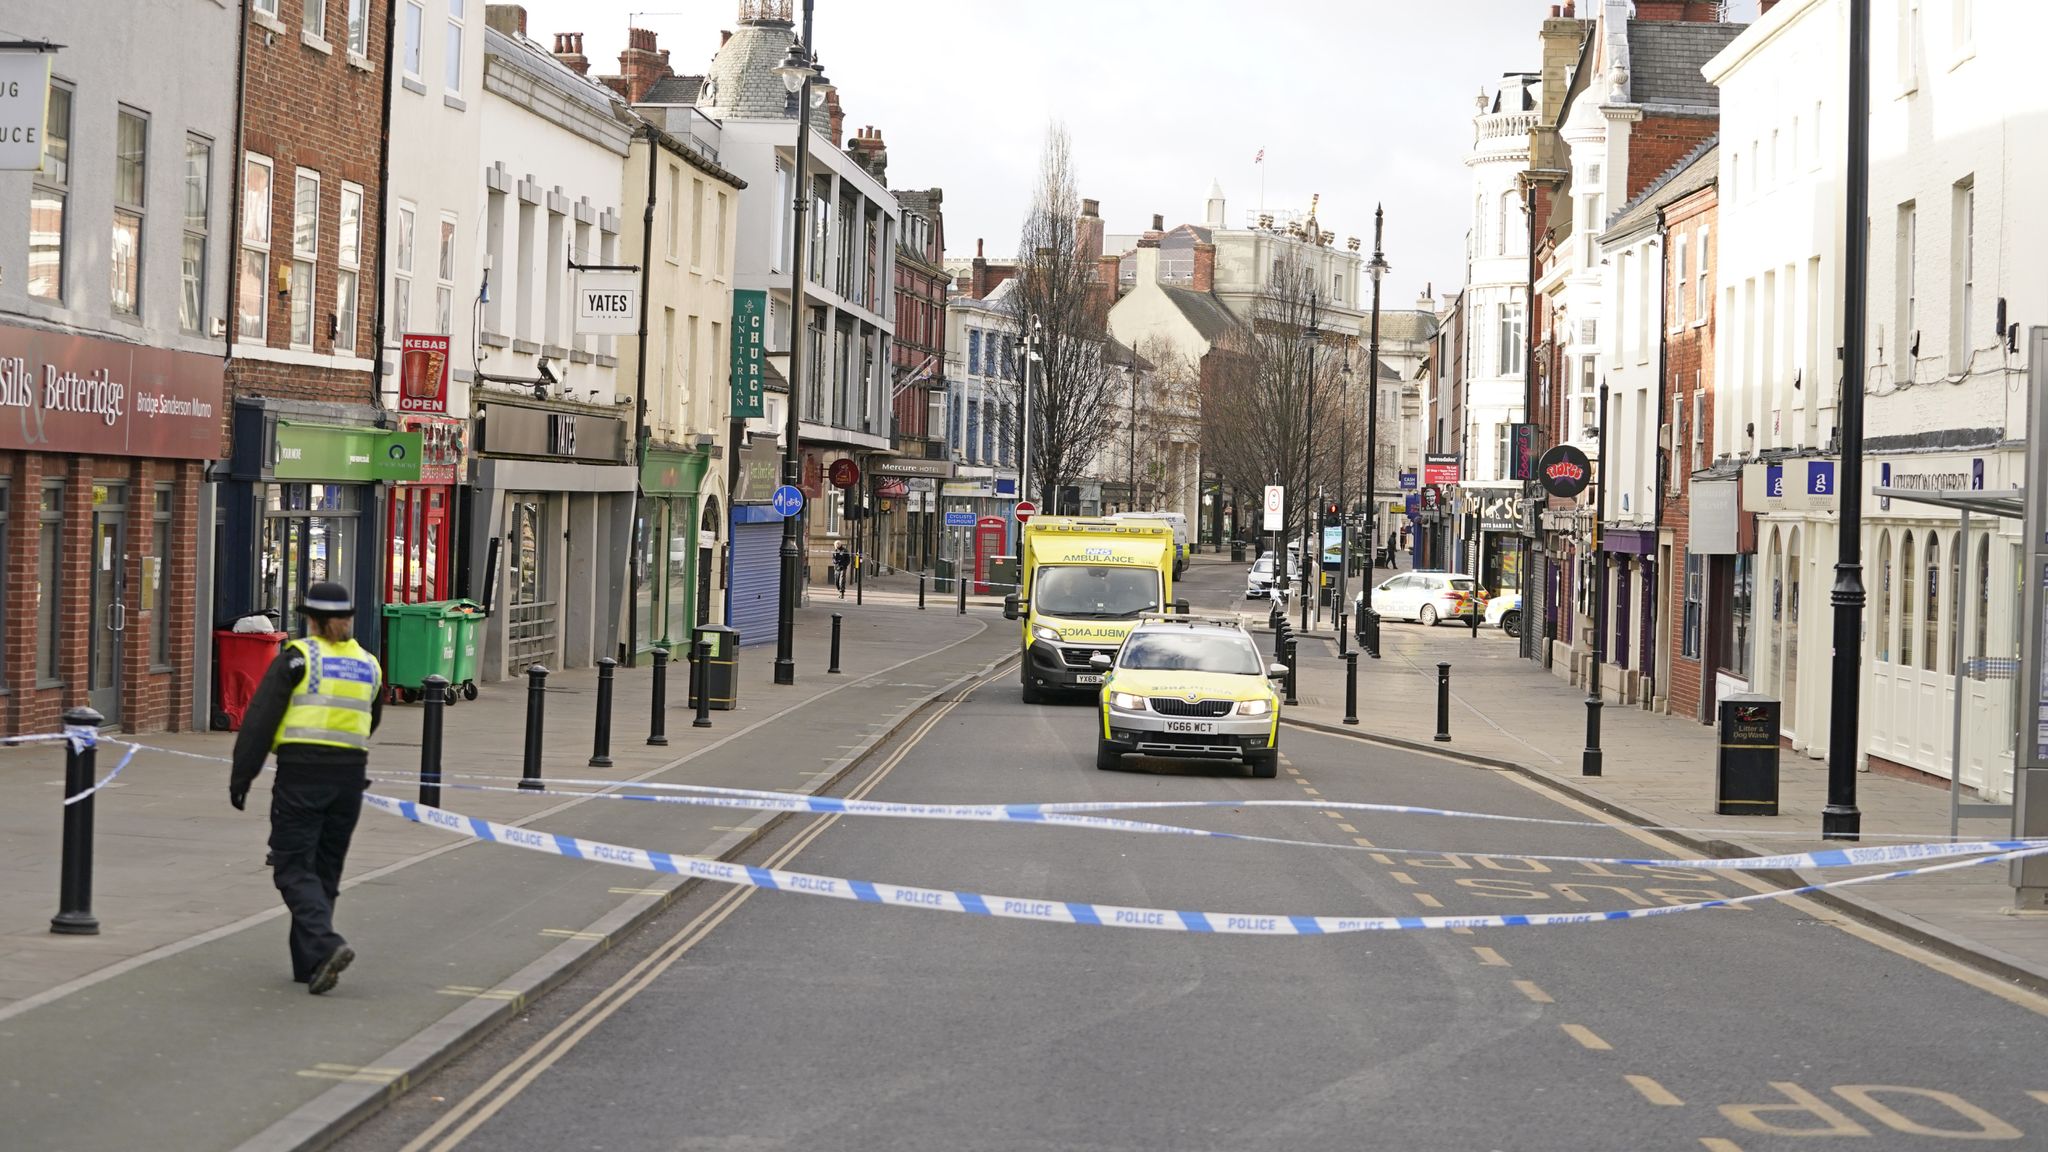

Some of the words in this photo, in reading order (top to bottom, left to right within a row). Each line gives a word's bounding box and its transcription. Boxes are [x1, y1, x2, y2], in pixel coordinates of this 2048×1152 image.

[588, 294, 627, 312] YATES
[404, 338, 447, 350] KEBAB
[736, 315, 745, 406] UNITARIAN
[749, 316, 760, 407] CHURCH
[0, 357, 32, 408] Sills
[44, 363, 124, 426] Betteridge
[137, 391, 158, 418] Bridge
[159, 394, 191, 416] Sanderson
[192, 397, 212, 418] Munro
[401, 398, 444, 411] OPEN
[882, 463, 917, 472] Mercure
[1546, 462, 1583, 480] flares
[1063, 555, 1134, 564] AMBULANCE
[1087, 548, 1112, 556] NHS
[1079, 675, 1097, 683] YX69
[1167, 721, 1192, 731] YG66
[1194, 722, 1213, 732] WCT
[427, 810, 460, 828] POLICE
[505, 828, 543, 847] POLICE
[593, 845, 635, 863] POLICE
[690, 860, 734, 878] POLICE
[790, 875, 835, 893] POLICE
[896, 889, 942, 906] POLICE
[1004, 901, 1053, 917] POLICE
[1115, 910, 1164, 926] POLICE
[1227, 917, 1276, 931] POLICE
[1339, 920, 1385, 930] POLICE
[1445, 919, 1490, 930] POLICE
